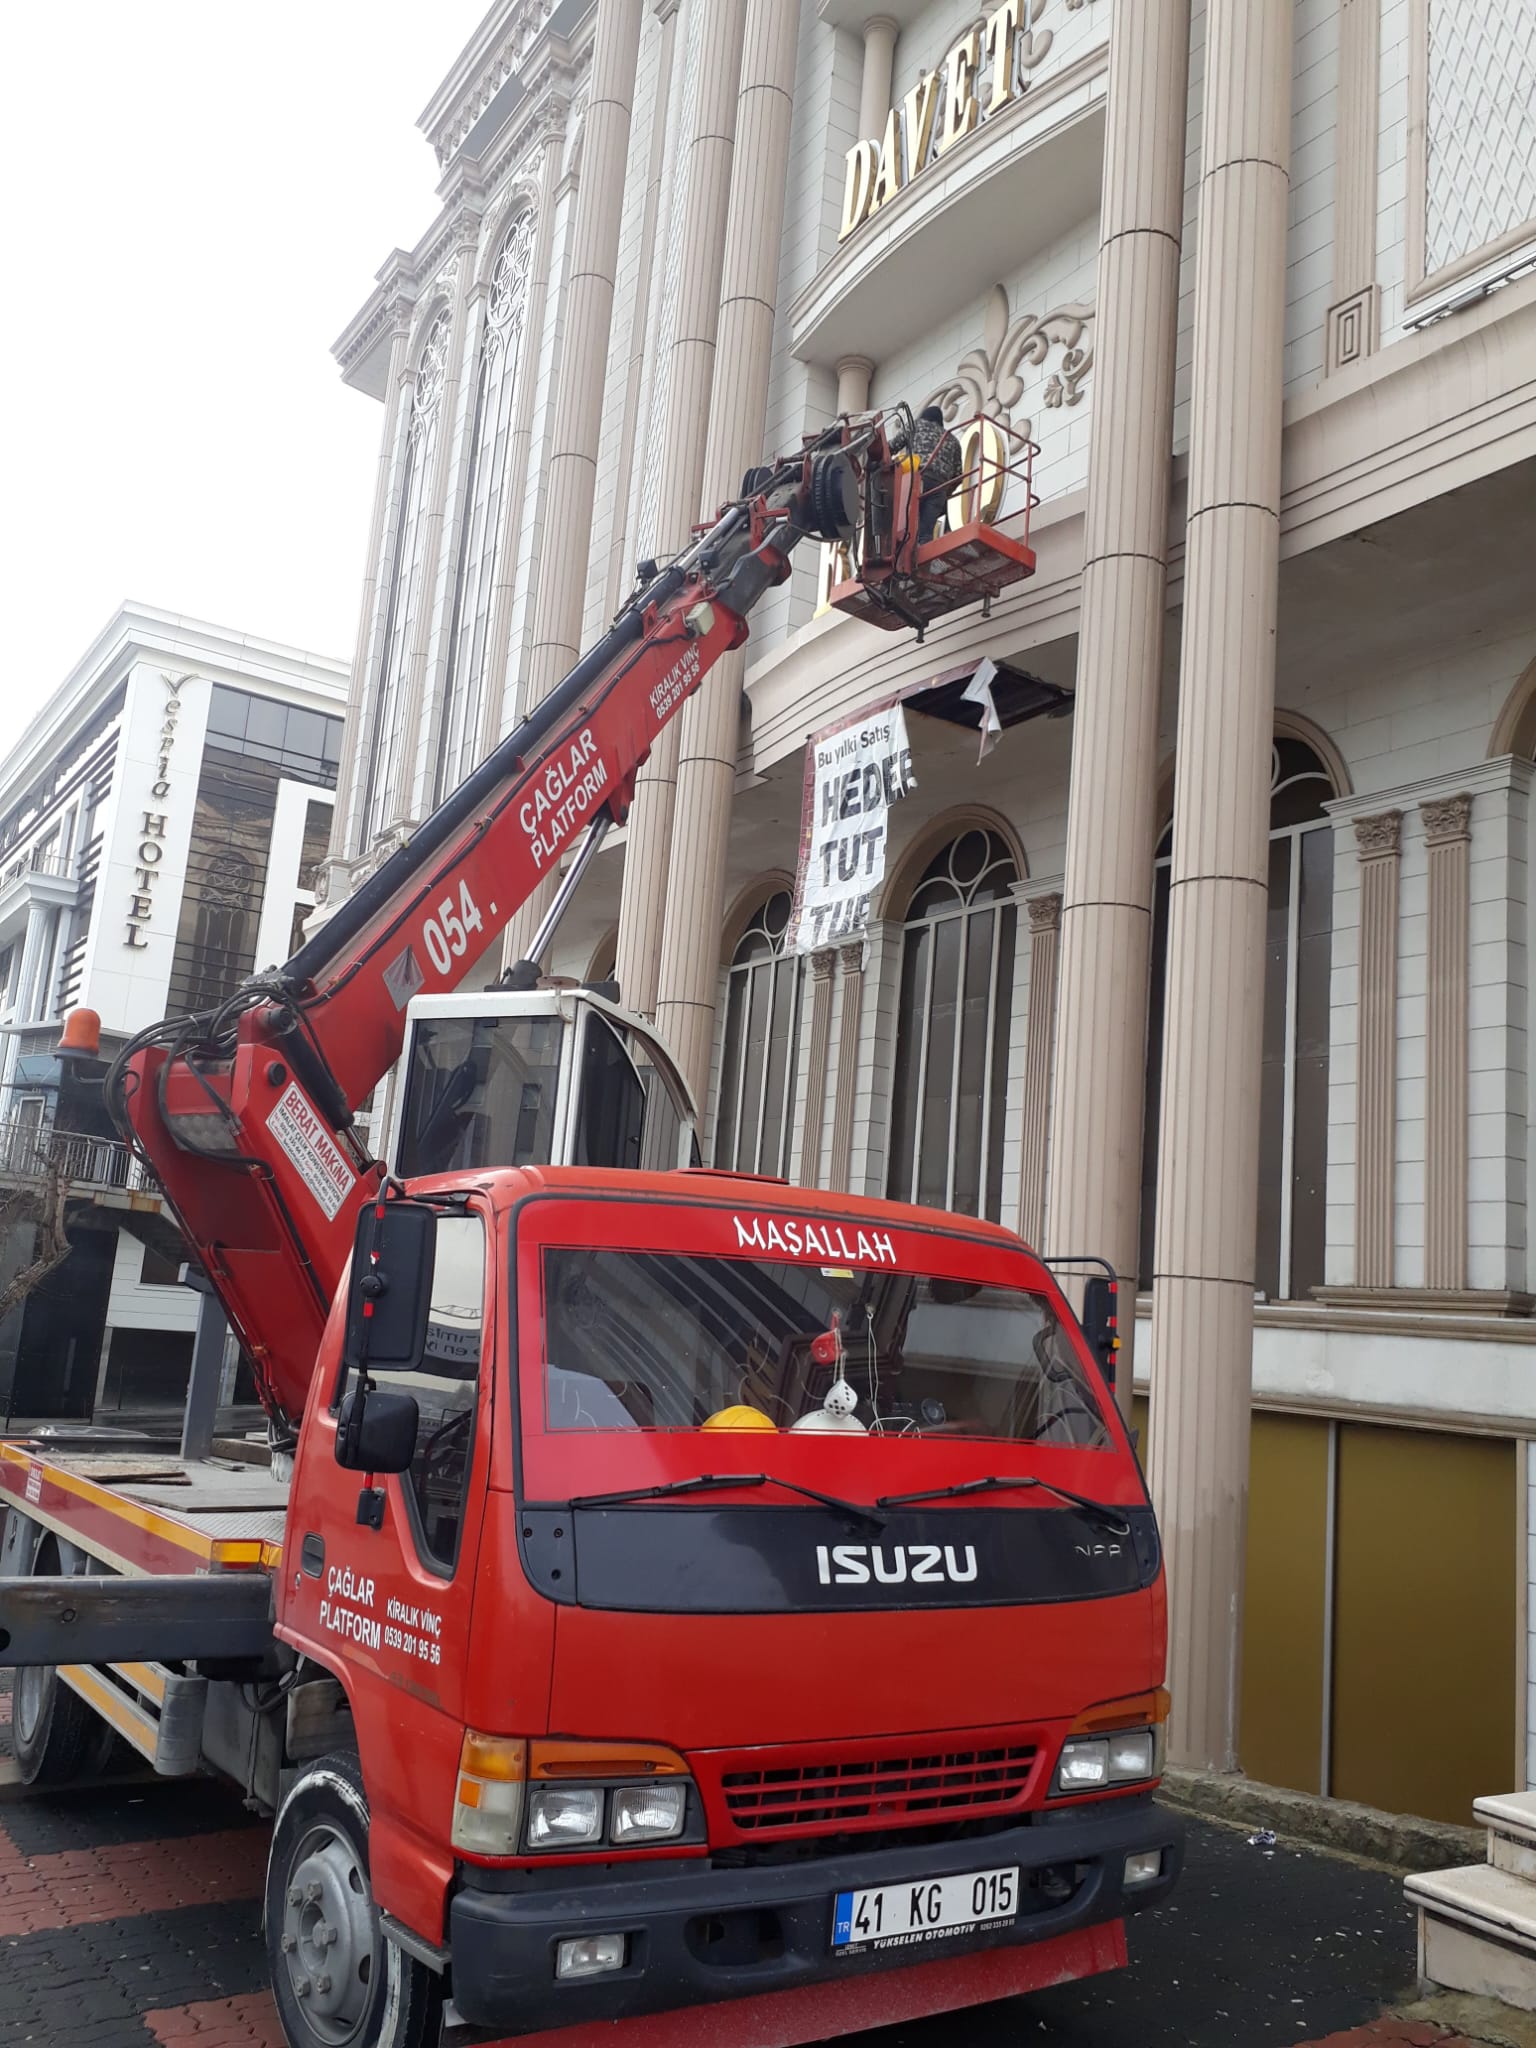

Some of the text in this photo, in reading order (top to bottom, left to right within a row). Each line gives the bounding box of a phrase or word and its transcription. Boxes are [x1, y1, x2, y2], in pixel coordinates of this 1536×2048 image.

[838, 0, 1022, 242] DAVET
[656, 694, 673, 720] 0539
[672, 680, 684, 701] 201
[683, 669, 692, 687] 95
[817, 725, 890, 769] Bu yılki Satış
[519, 728, 598, 841] ÇAĞLAR
[123, 672, 199, 950] Vespia HOTEL
[530, 760, 609, 868] PLATFORM
[819, 826, 884, 887] TUT
[285, 1088, 318, 1141] BERAT
[733, 1215, 897, 1264] MAŞALLAH
[327, 1565, 375, 1608] ÇAĞLAR
[816, 1545, 978, 1584] ISUZU
[319, 1600, 381, 1650] PLATFORM
[386, 1596, 442, 1640] KİRALIK VİNÇ
[384, 1625, 441, 1665] 0539 201 95 56
[837, 1872, 1013, 1934] TR 41 KG 015
[873, 1932, 924, 1950] YÜKSELEN
